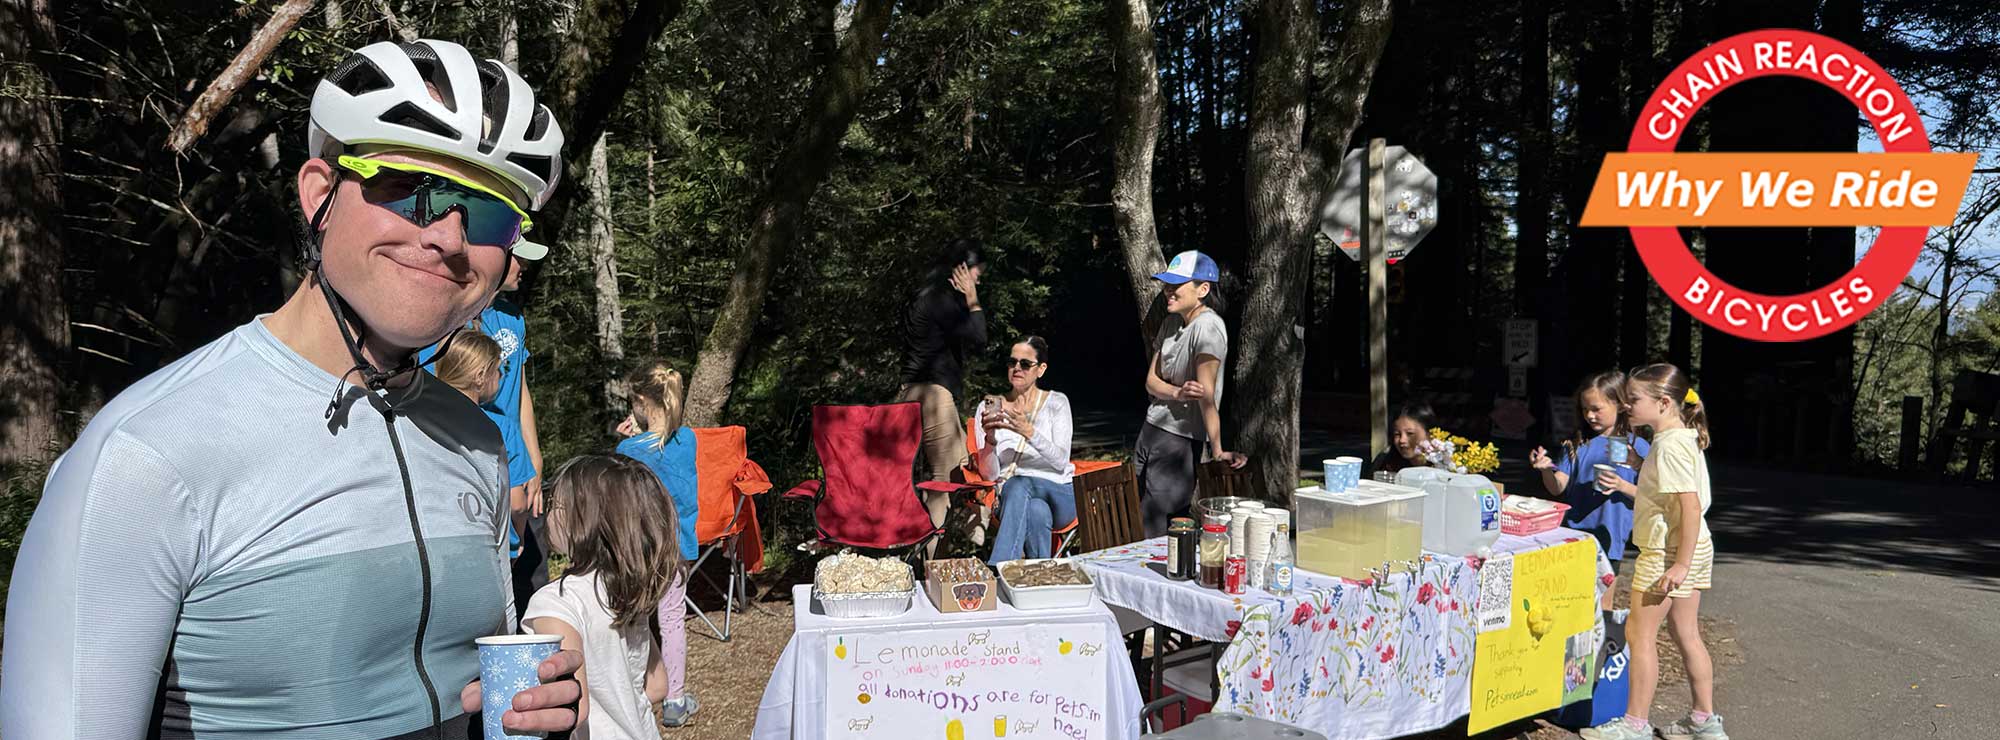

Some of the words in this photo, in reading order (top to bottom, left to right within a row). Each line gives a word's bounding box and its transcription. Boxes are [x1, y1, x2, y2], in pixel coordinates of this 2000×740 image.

[1533, 574, 1568, 598] STAND
[1483, 616, 1505, 626] venmo
[855, 637, 968, 664] Lemonade
[863, 669, 882, 681] on
[859, 684, 878, 695] all
[885, 684, 981, 713] donations
[986, 690, 1020, 703] are
[1029, 690, 1051, 705] for
[1089, 709, 1101, 722] in
